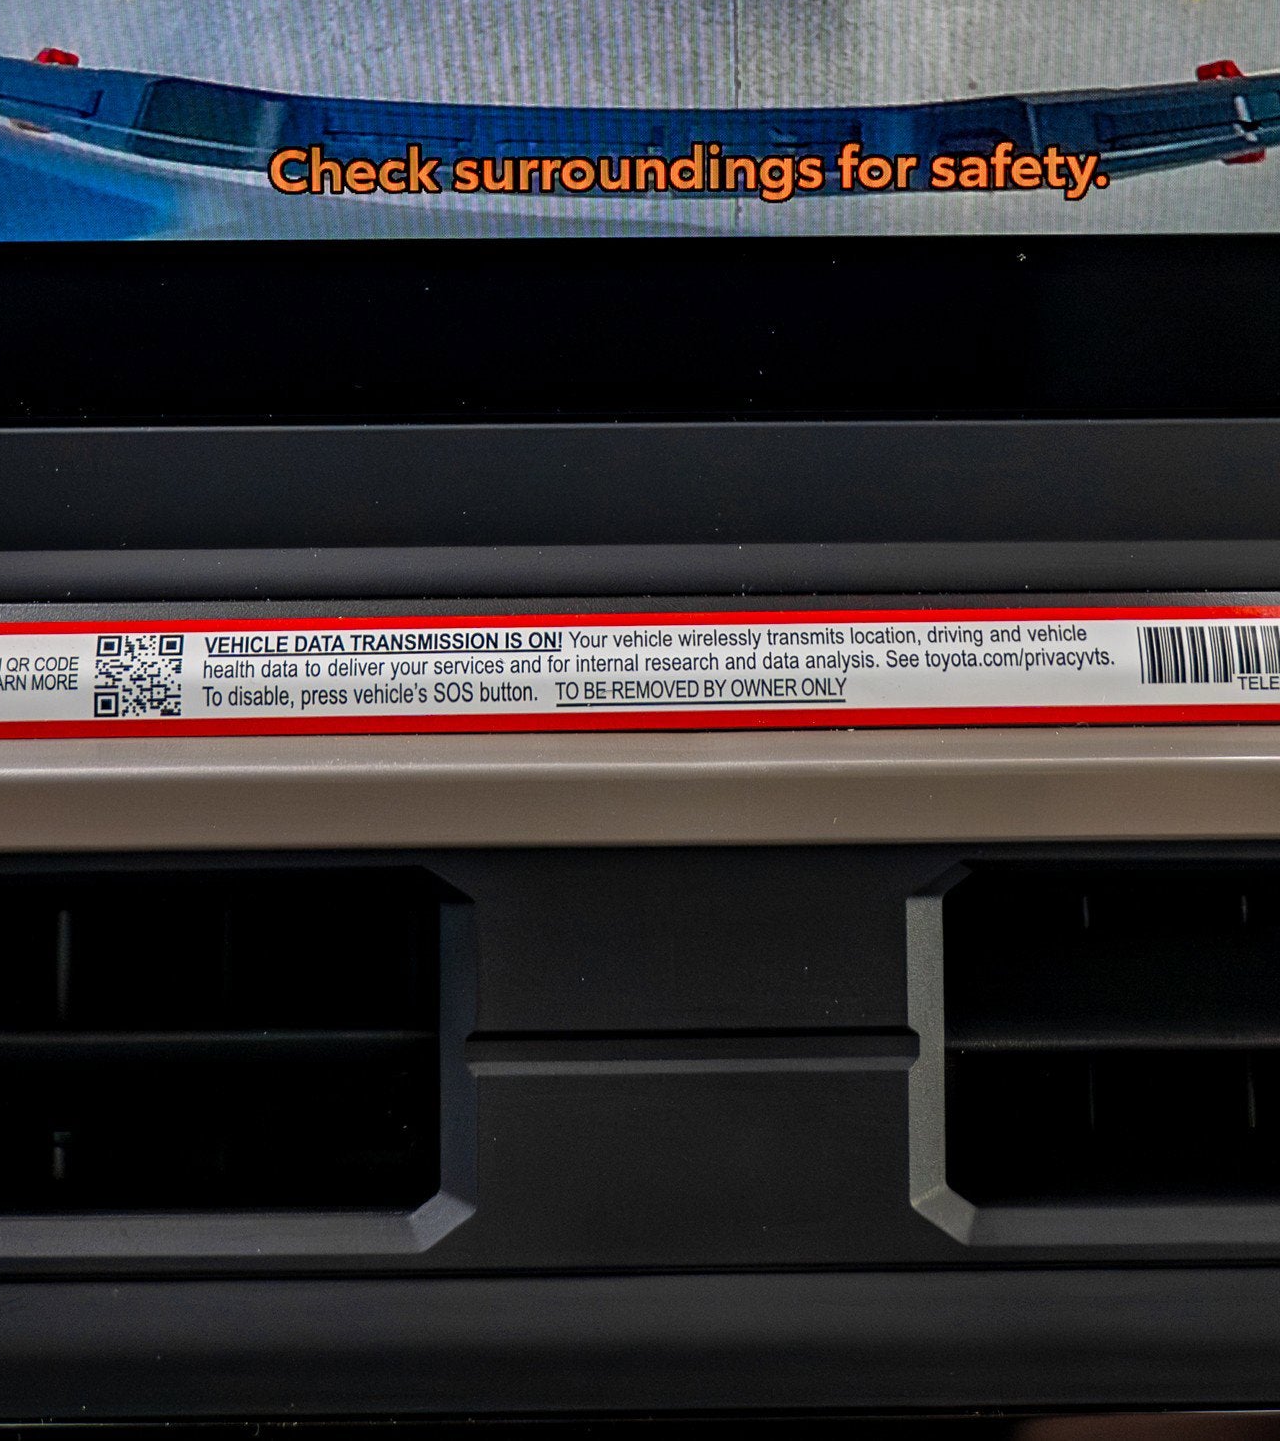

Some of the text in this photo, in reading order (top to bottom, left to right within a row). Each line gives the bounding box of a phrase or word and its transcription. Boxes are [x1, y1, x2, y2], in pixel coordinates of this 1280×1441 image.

[268, 143, 1111, 202] Check surroundings for safety.
[204, 625, 1087, 654] VEHICLE DATA TRANSMISSION IS ON! Your vehicle wirelessly transmits location, driving and vehicle
[7, 658, 29, 672] QR
[34, 657, 79, 671] CODE
[203, 648, 1115, 681] health data to deliver your services and for internal research and data analysis. See toyota.com/privacyvts.
[32, 674, 78, 690] MORE
[203, 686, 222, 707] To
[229, 685, 294, 708] disable,
[301, 686, 348, 709] press
[434, 682, 473, 703] SOS
[480, 681, 538, 702] button.
[555, 682, 579, 700] TO
[584, 681, 606, 699] BE
[612, 680, 699, 699] REMOVED
[704, 680, 727, 697] BY
[731, 678, 797, 697] OWNER
[802, 677, 847, 696] ONLY
[1237, 676, 1280, 690] TELE
